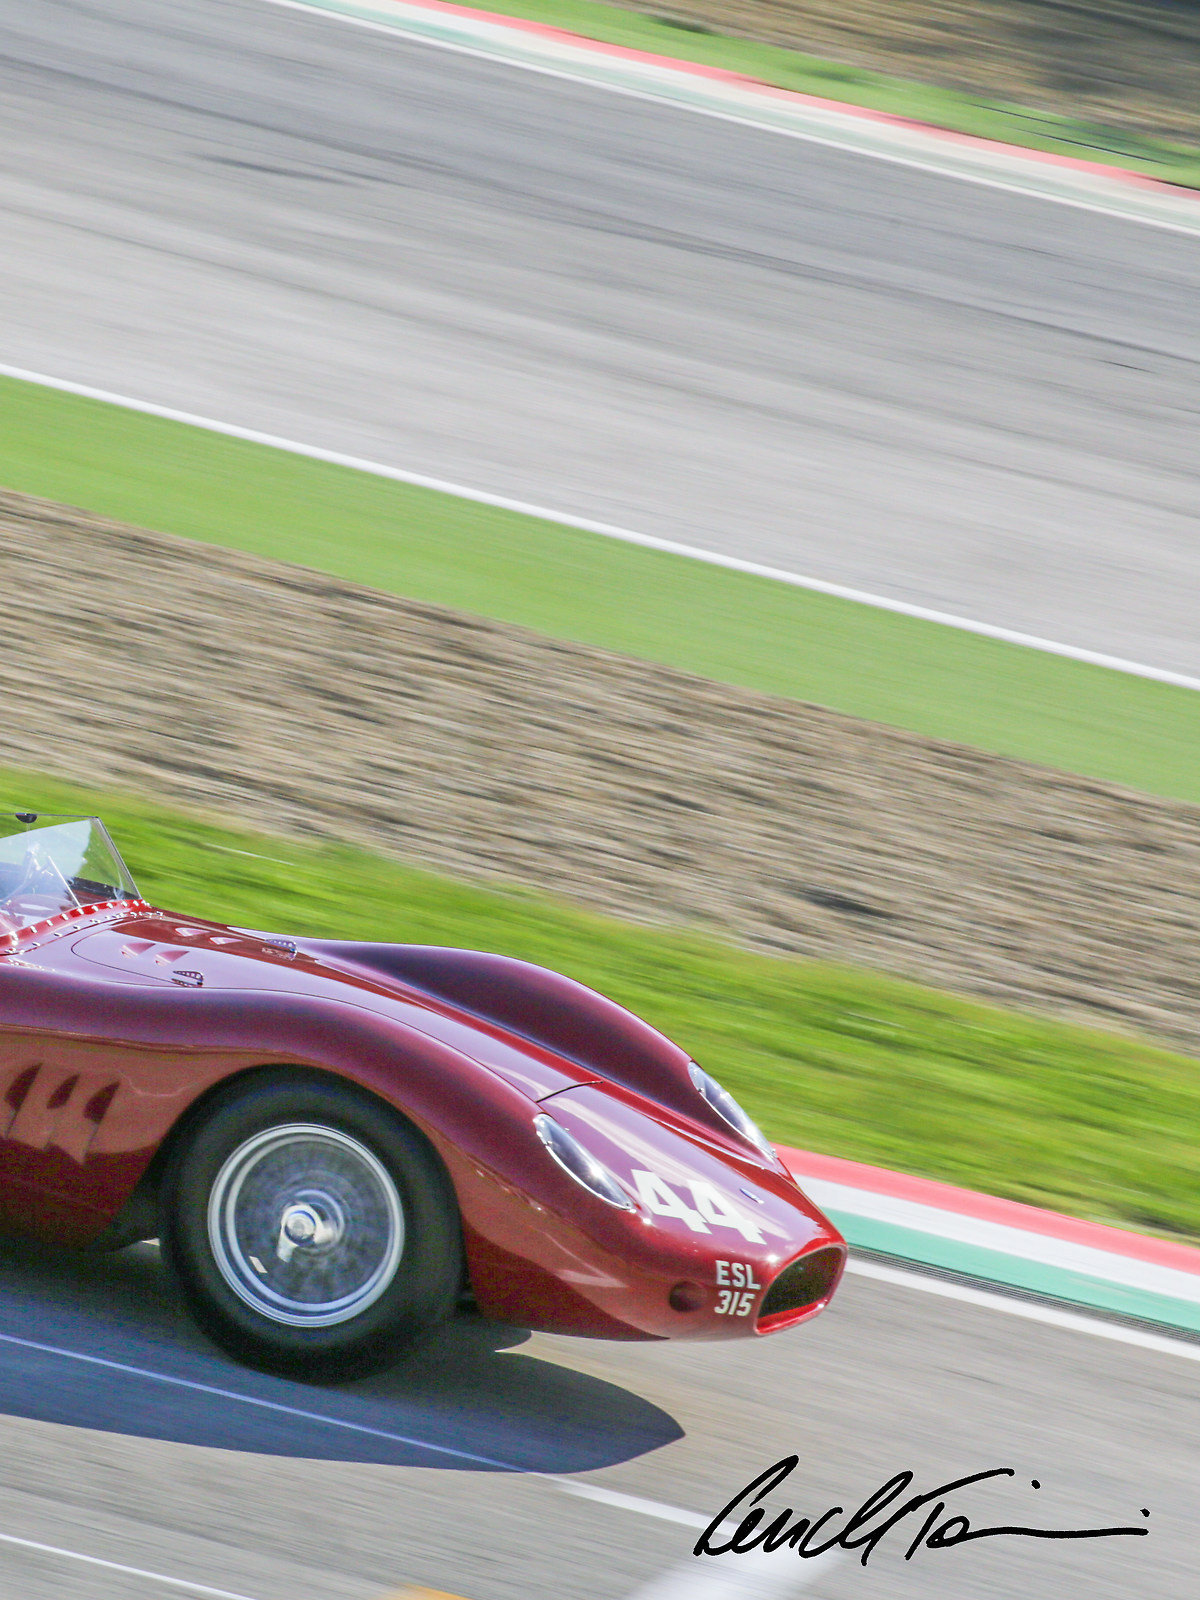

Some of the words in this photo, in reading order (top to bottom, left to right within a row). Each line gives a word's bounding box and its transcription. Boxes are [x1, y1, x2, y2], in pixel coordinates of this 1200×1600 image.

[631, 1169, 766, 1244] 44
[715, 1260, 761, 1289] ESL
[714, 1290, 755, 1316] 315
